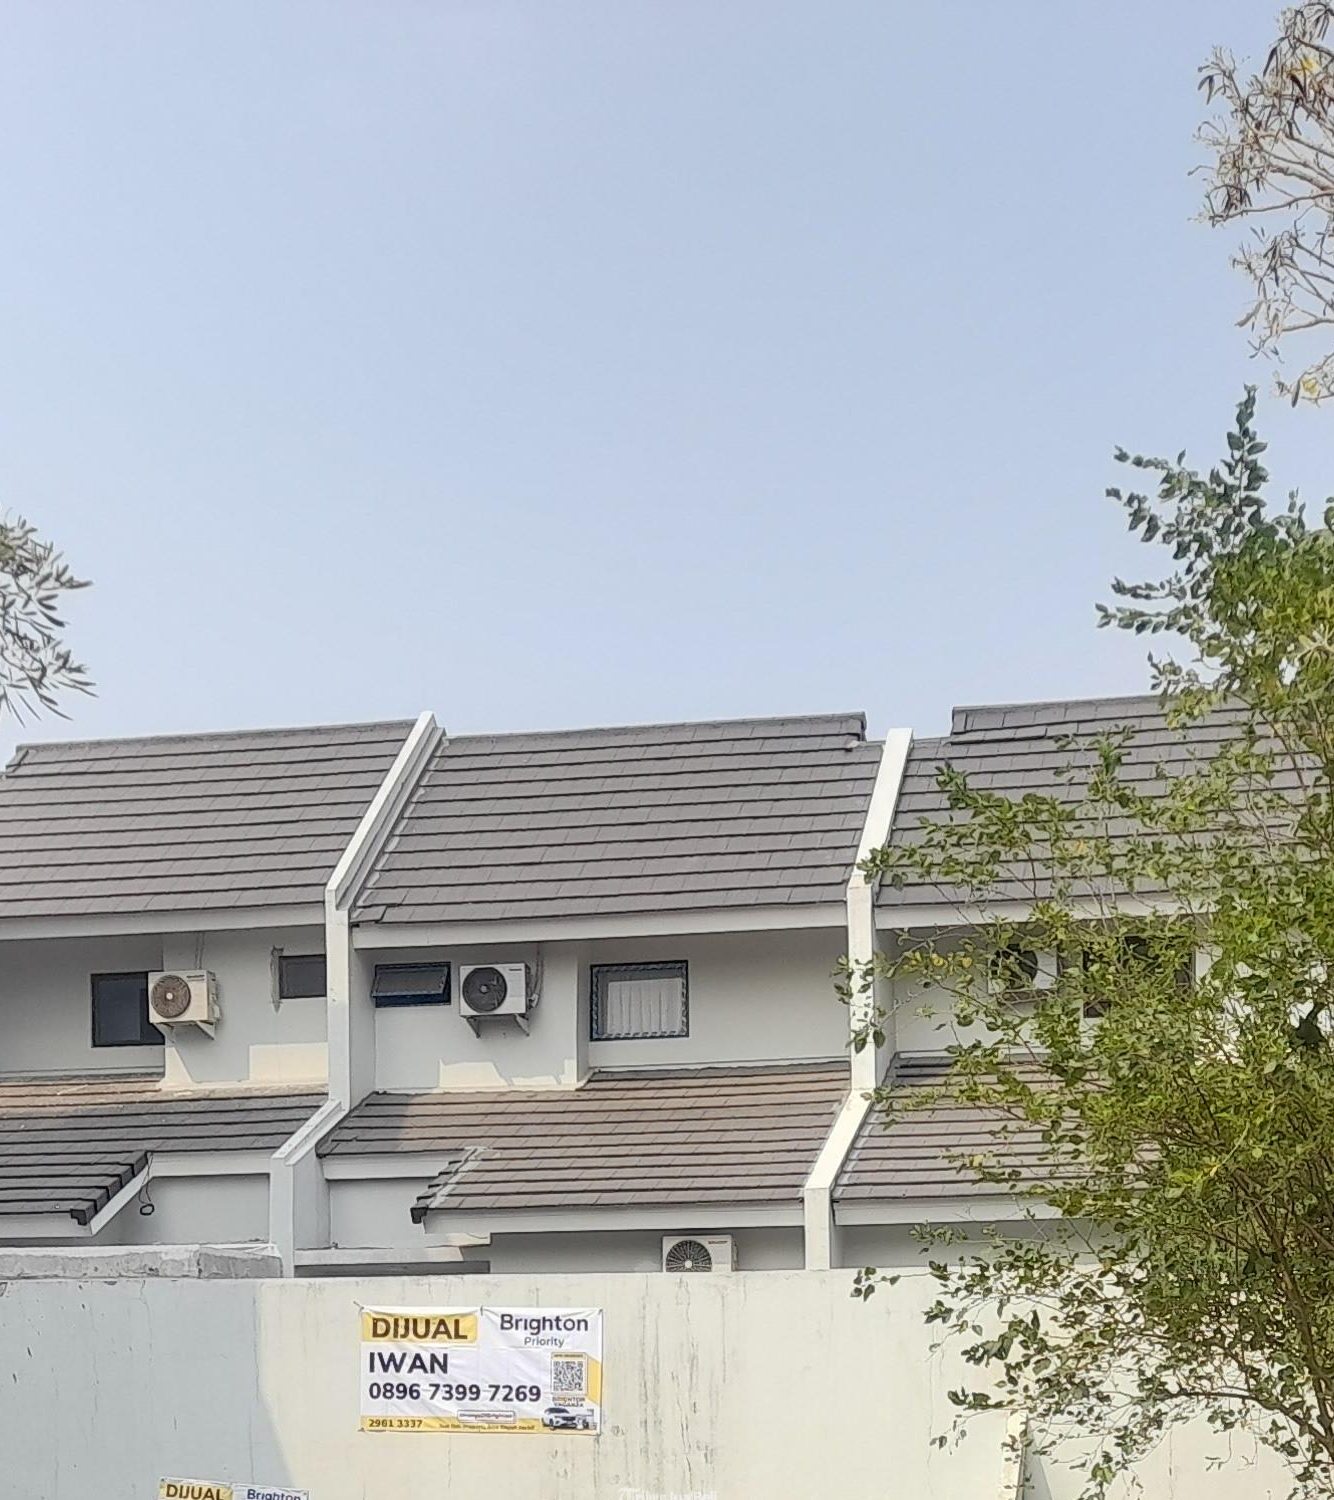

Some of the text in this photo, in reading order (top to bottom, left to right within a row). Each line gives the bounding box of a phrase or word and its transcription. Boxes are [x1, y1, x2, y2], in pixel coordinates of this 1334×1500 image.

[371, 1317, 469, 1340] DIJUAL
[499, 1313, 589, 1335] Brighton
[523, 1336, 566, 1348] Priority
[368, 1351, 449, 1375] IWAN
[368, 1382, 542, 1403] 0896 7399 7269
